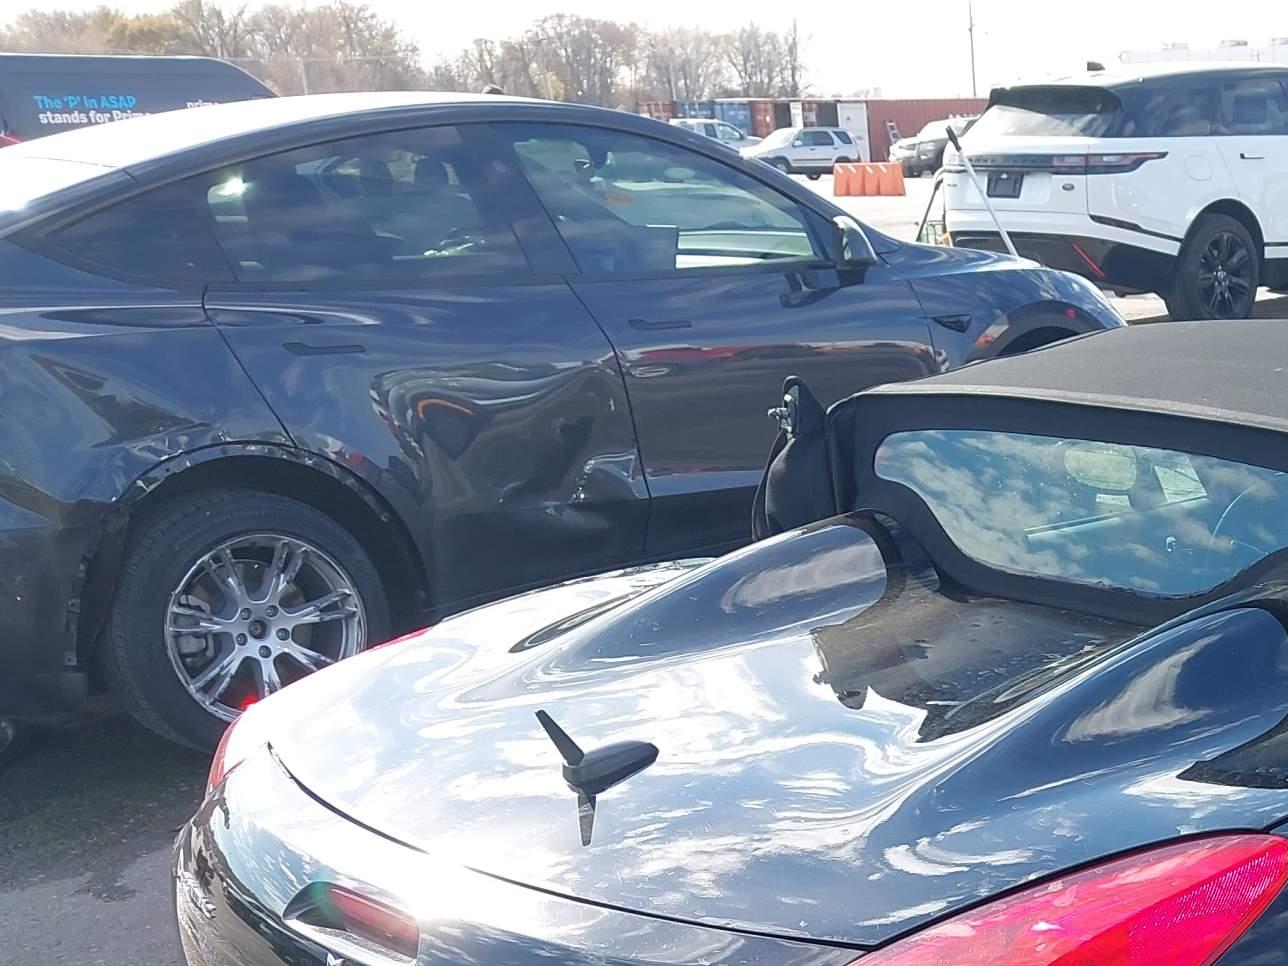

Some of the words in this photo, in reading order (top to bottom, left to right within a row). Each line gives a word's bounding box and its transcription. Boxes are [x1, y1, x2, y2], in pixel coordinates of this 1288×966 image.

[33, 96, 62, 109] The
[83, 96, 98, 109] in
[101, 95, 136, 109] ASAP
[39, 111, 88, 124] stands
[89, 110, 111, 124] for
